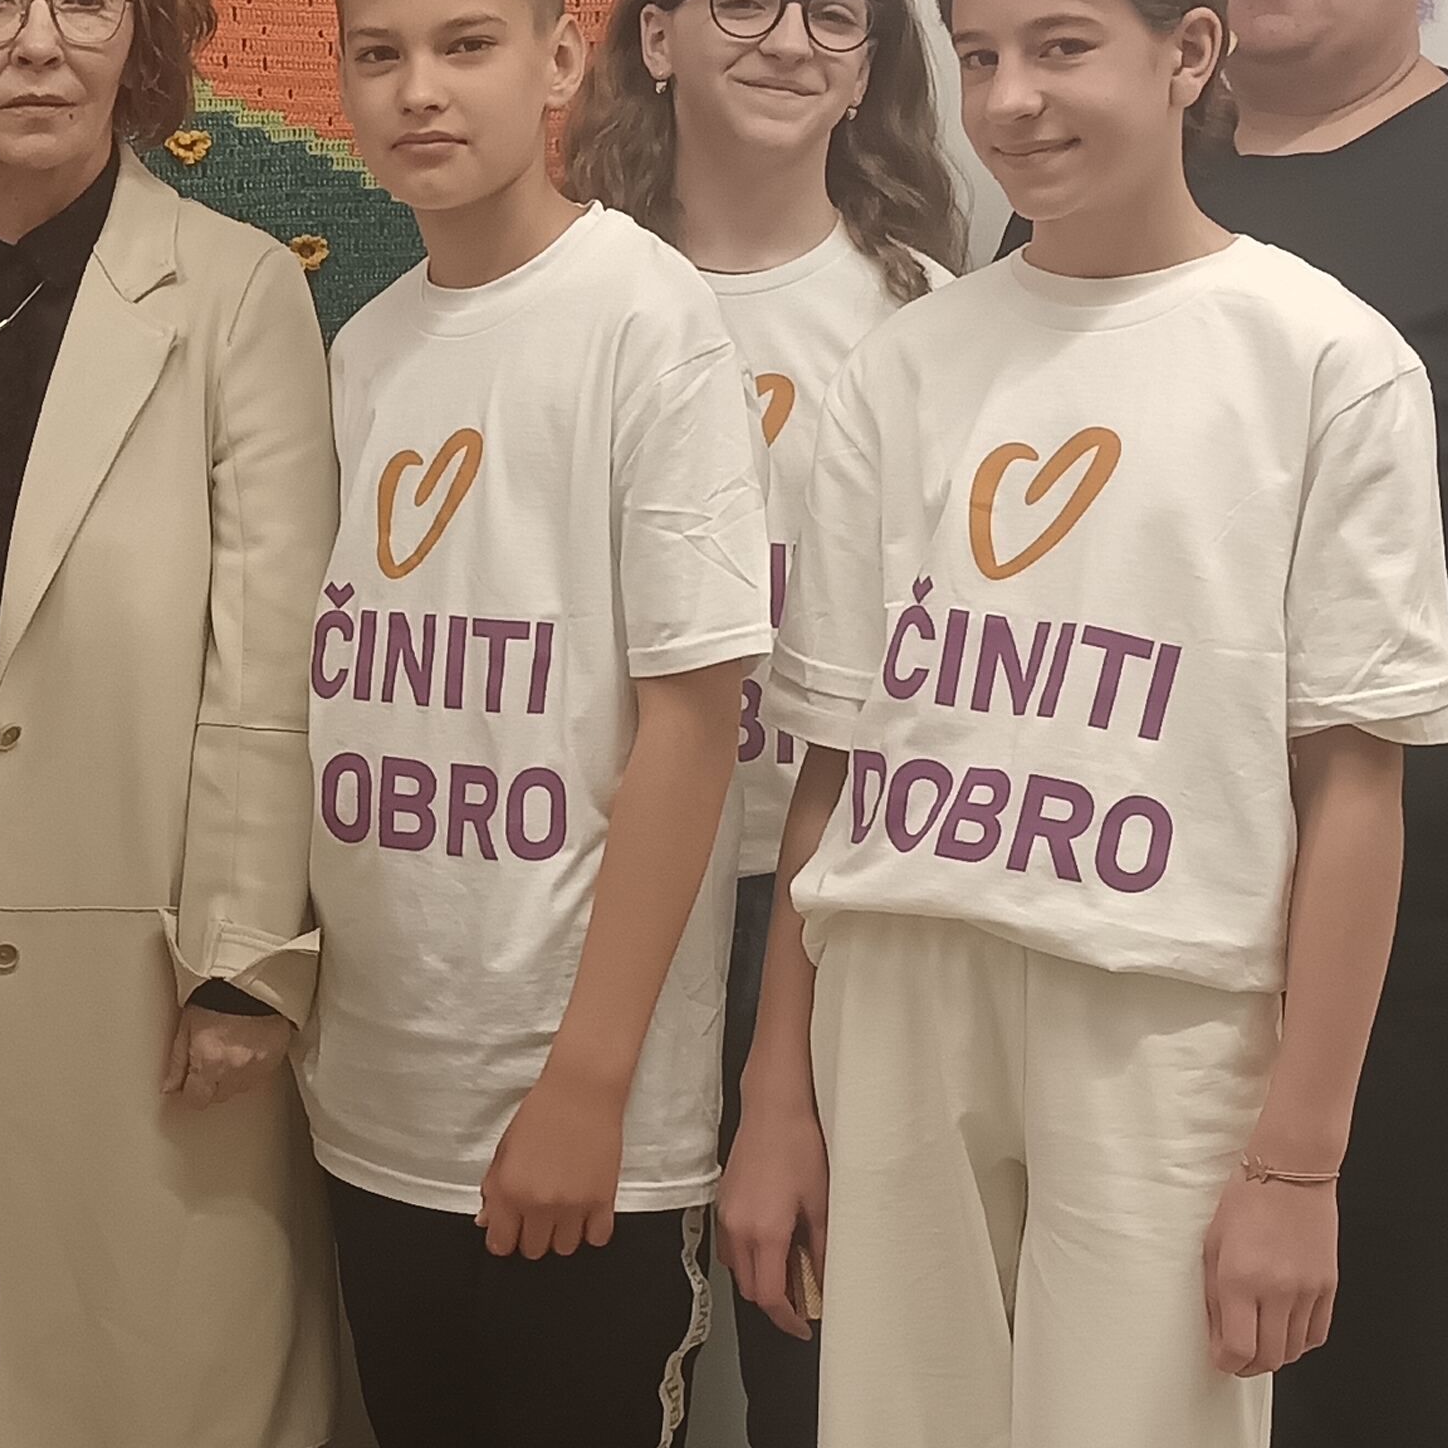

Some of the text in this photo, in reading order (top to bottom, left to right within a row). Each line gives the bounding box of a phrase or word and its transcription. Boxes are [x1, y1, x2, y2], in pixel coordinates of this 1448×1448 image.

[310, 581, 555, 715] ČINITI
[882, 575, 1183, 742] ČINITI
[320, 751, 568, 862] OBRO
[849, 749, 1174, 894] DOBRO
